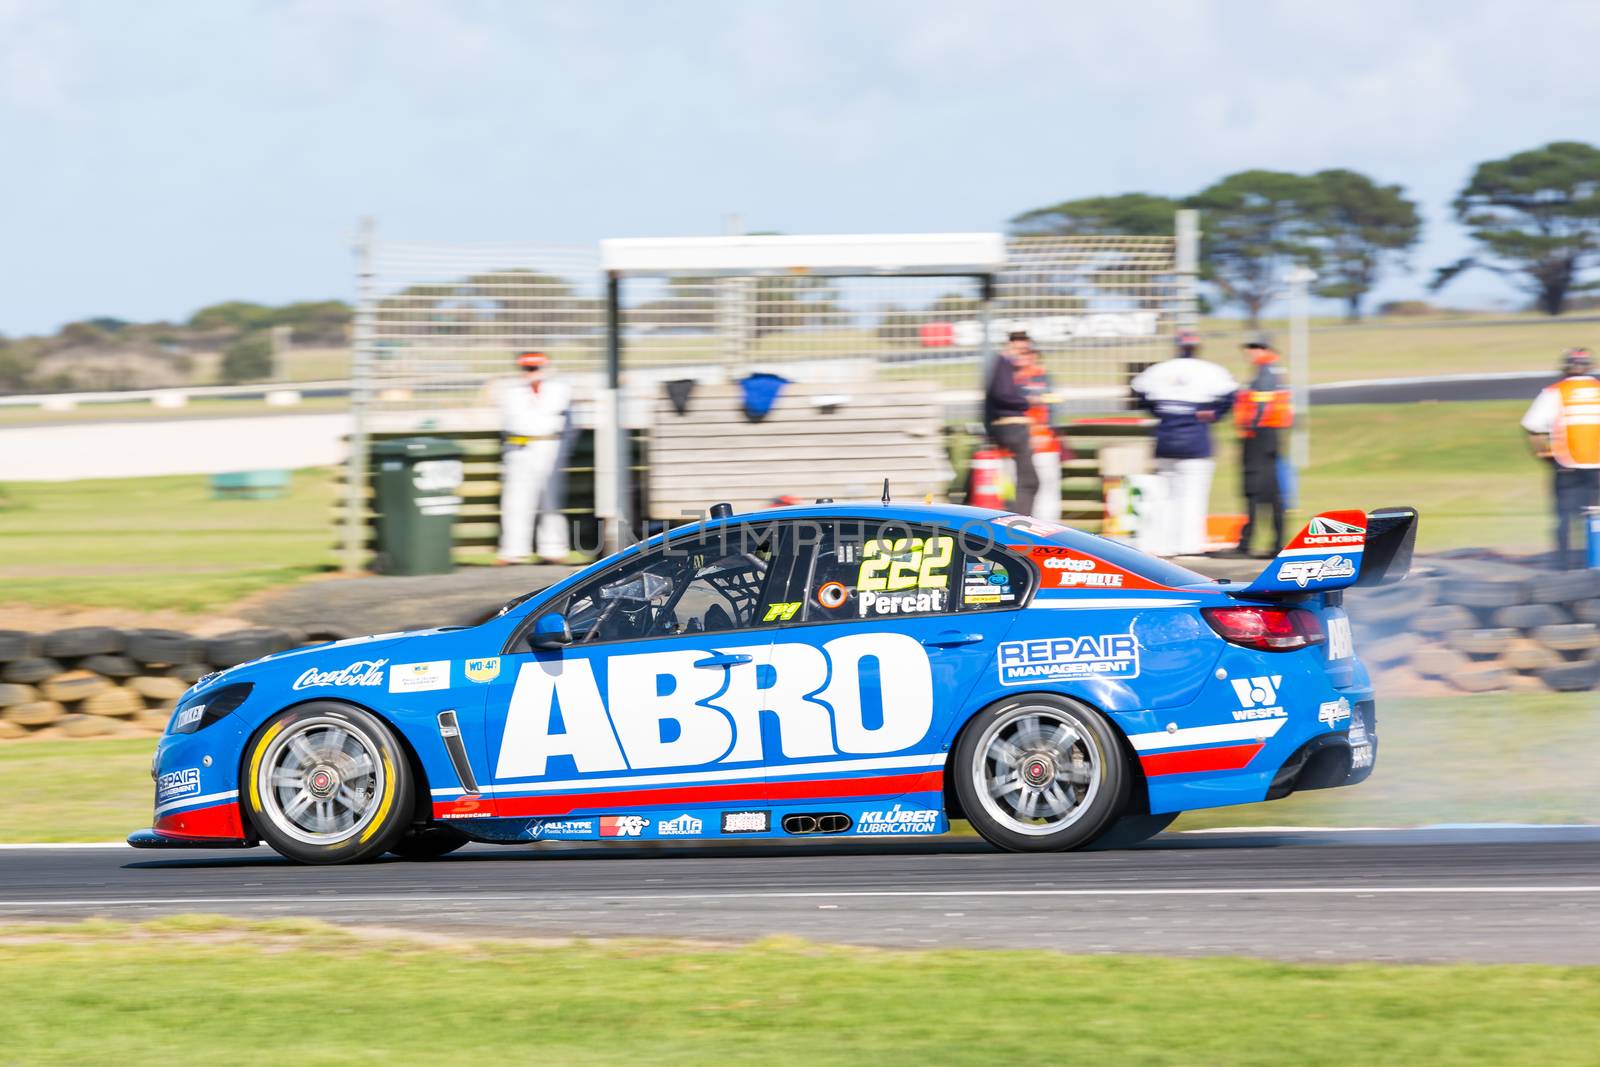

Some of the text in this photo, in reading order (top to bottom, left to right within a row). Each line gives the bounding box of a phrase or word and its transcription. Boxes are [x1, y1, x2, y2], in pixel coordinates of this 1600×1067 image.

[857, 537, 954, 592] 222
[859, 589, 942, 618] Percat
[1001, 637, 1135, 664] REPAIR
[1007, 660, 1130, 678] MANAGEMENT
[495, 632, 934, 779] ABRO
[1231, 706, 1288, 721] WESFIL
[658, 813, 702, 830] BETTA
[860, 804, 939, 824] KLÜBER
[544, 821, 592, 829] ALL-TYPE
[856, 823, 935, 833] LUBRICATION
